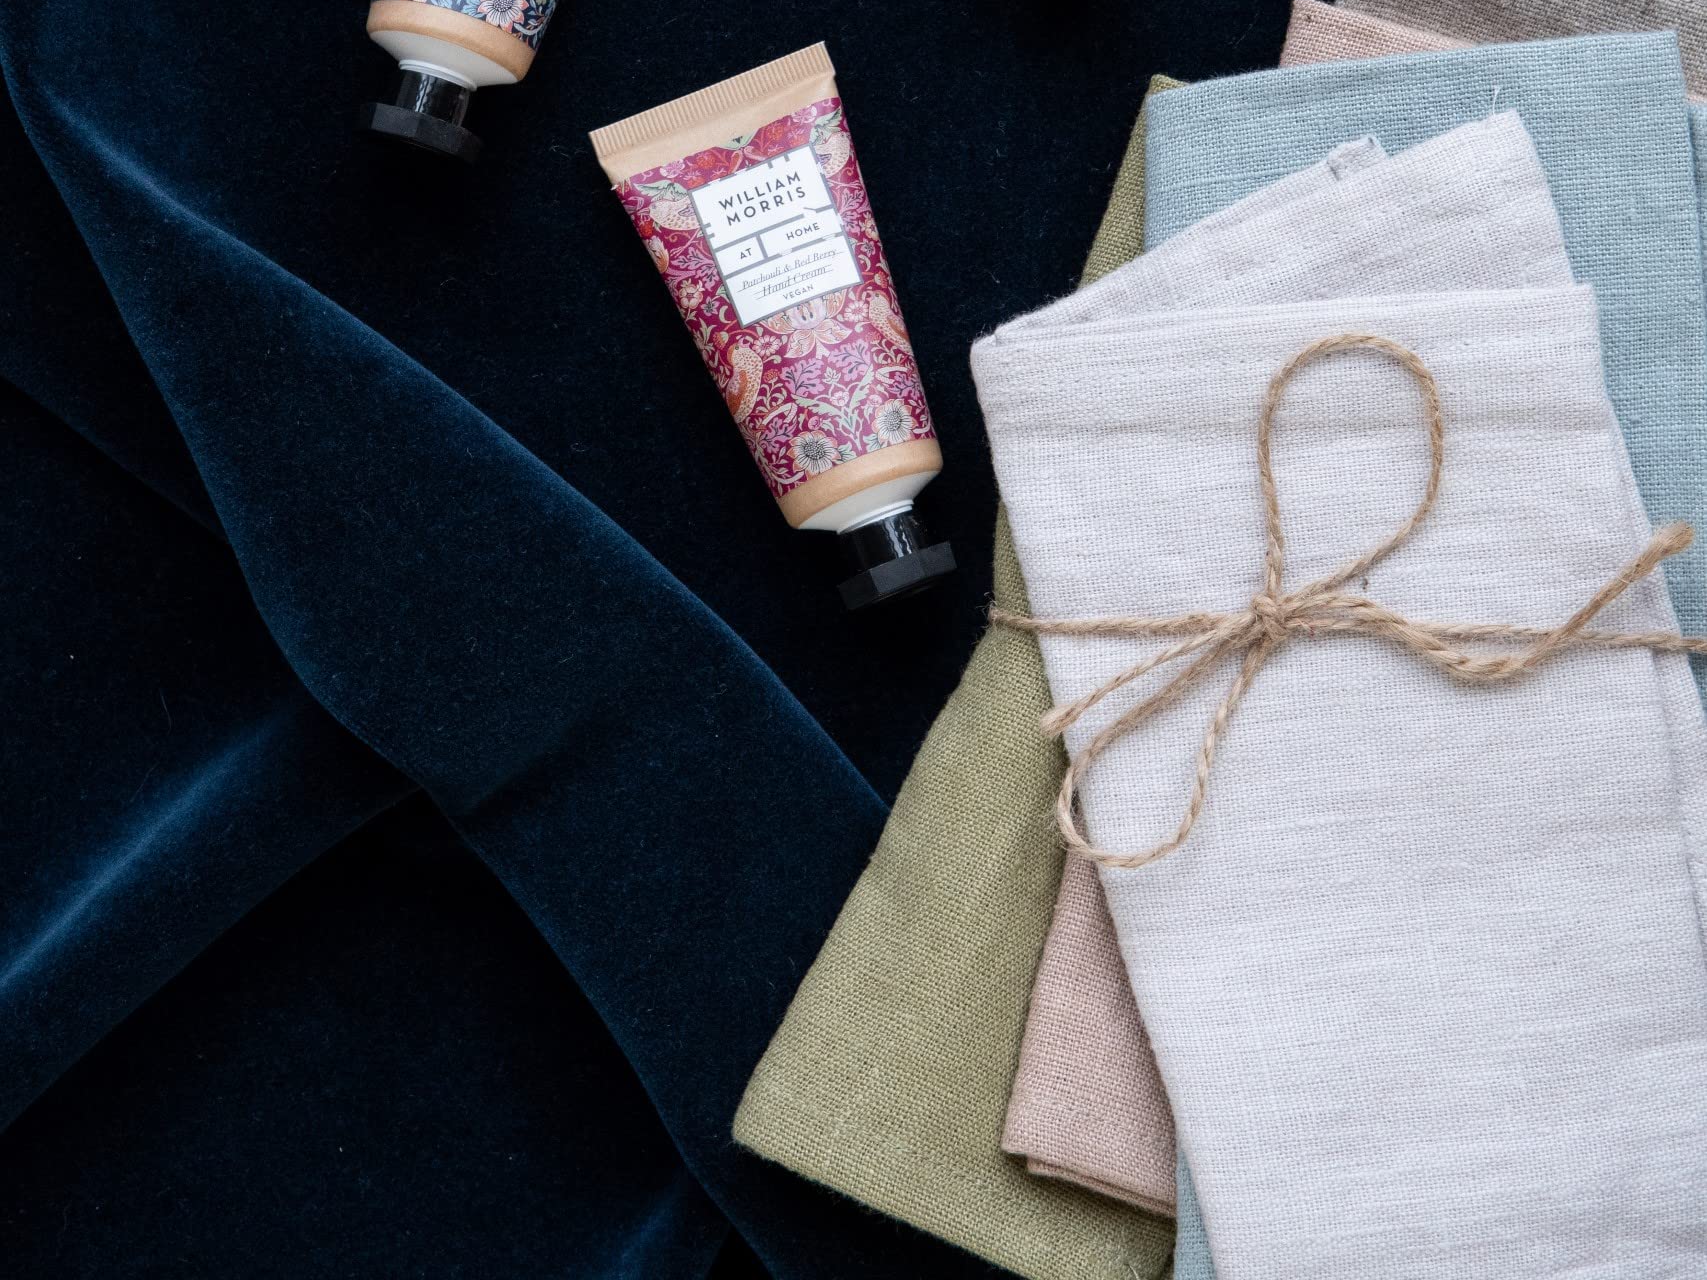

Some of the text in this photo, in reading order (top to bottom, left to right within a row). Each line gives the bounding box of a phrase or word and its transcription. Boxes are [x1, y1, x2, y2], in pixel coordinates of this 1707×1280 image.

[719, 172, 800, 210] WILLIAM
[727, 187, 805, 226] MORRIS
[740, 223, 820, 260] AT HOME
[782, 263, 790, 272] &
[794, 256, 810, 268] Red
[762, 266, 826, 297] Hand Cream
[783, 284, 814, 299] VEGAN
